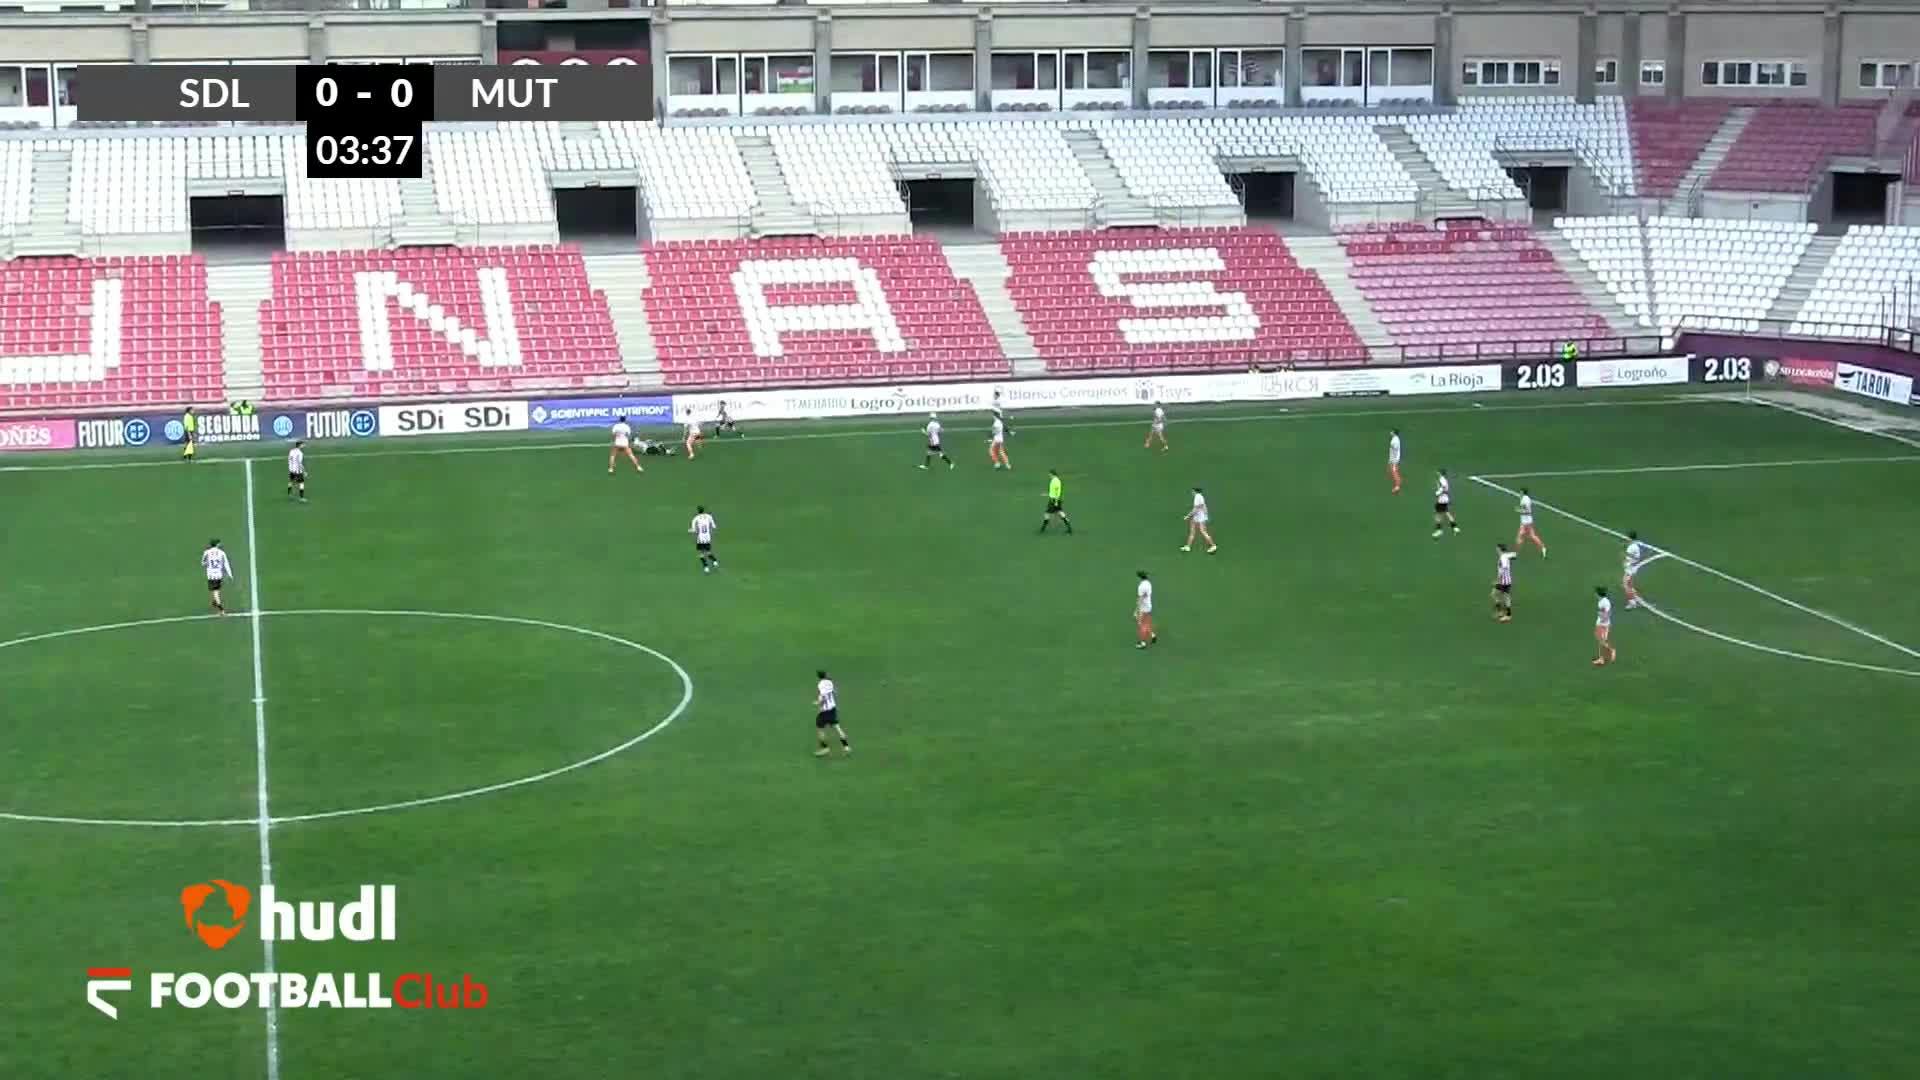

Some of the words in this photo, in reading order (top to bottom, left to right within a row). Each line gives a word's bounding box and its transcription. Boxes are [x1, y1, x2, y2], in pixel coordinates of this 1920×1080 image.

[1518, 363, 1565, 389] 2.03
[1704, 357, 1751, 381] 2.03
[1431, 374, 1446, 387] La
[1449, 373, 1484, 389] Rioja
[1856, 371, 1892, 397] TARON
[197, 415, 260, 434] SEGUNDA
[397, 409, 444, 432] SDi
[463, 406, 511, 428] SDi
